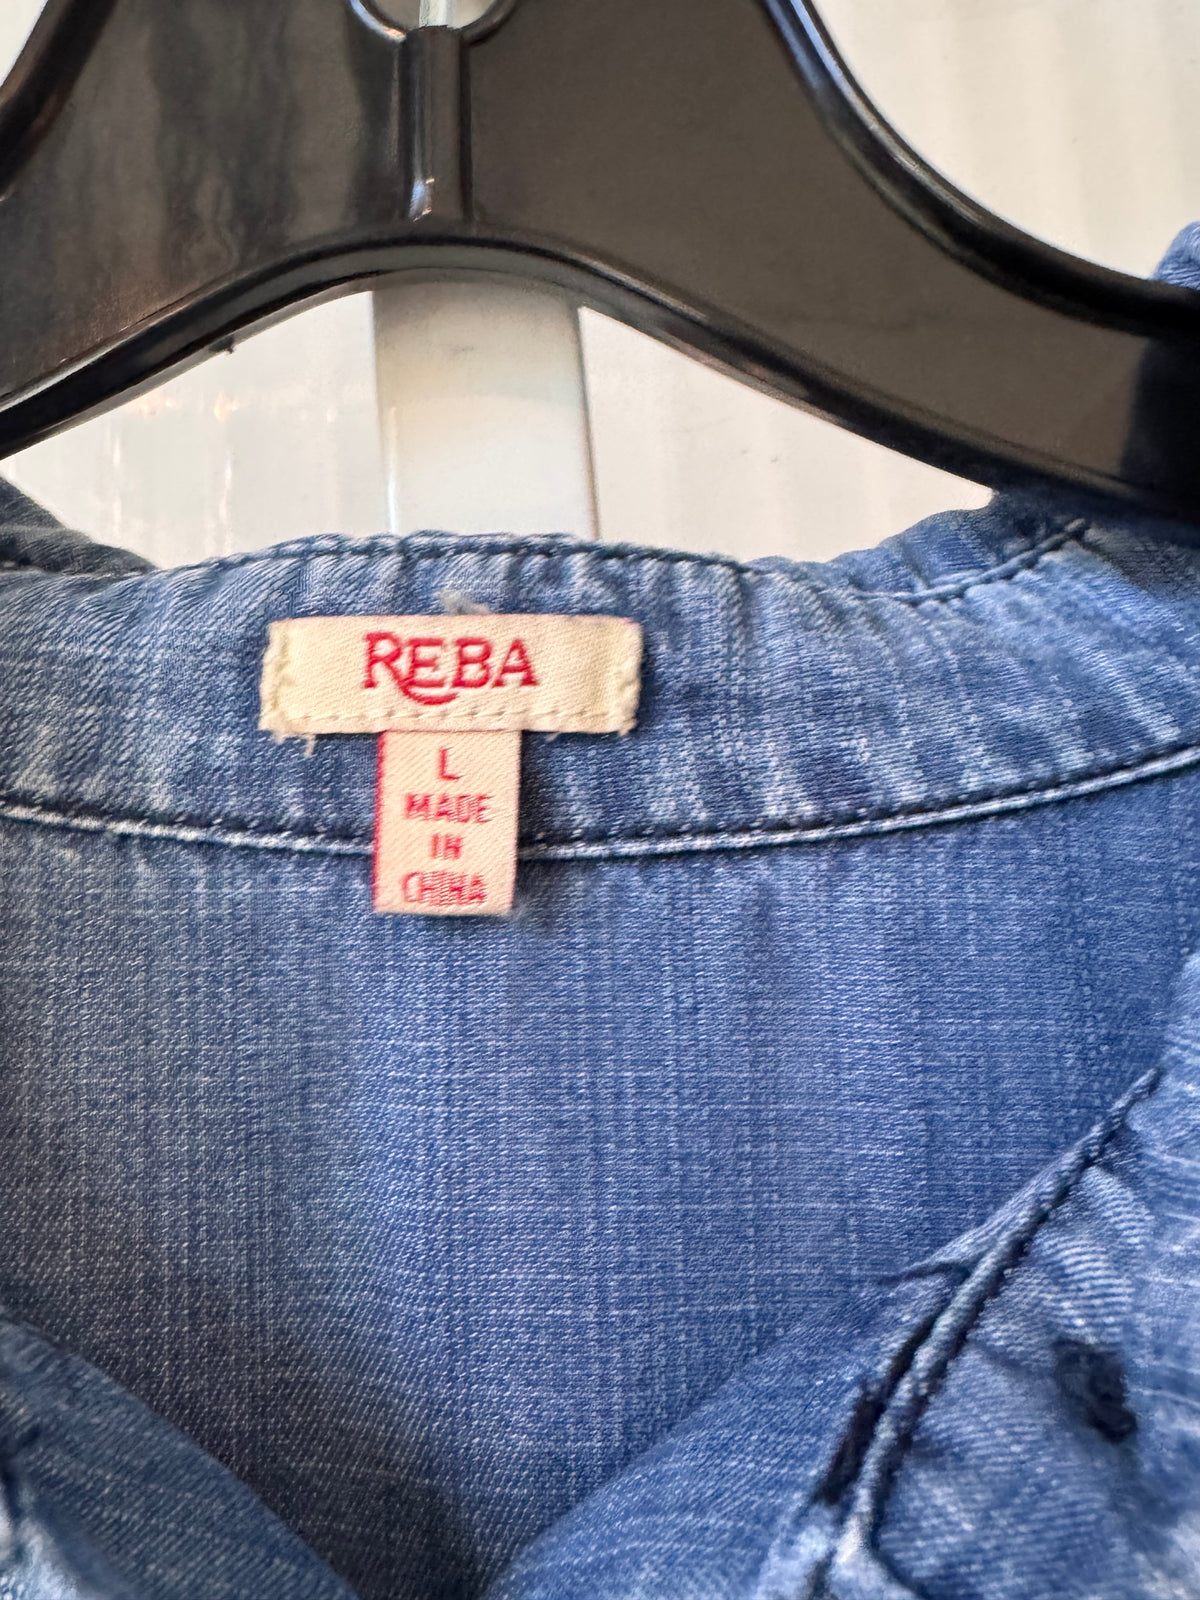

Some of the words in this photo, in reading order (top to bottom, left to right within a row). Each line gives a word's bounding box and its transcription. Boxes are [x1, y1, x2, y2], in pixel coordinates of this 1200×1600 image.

[362, 631, 538, 706] REBA
[438, 748, 462, 781] L
[405, 793, 491, 823] MADE
[431, 834, 463, 860] IN
[402, 871, 487, 906] CHINA
